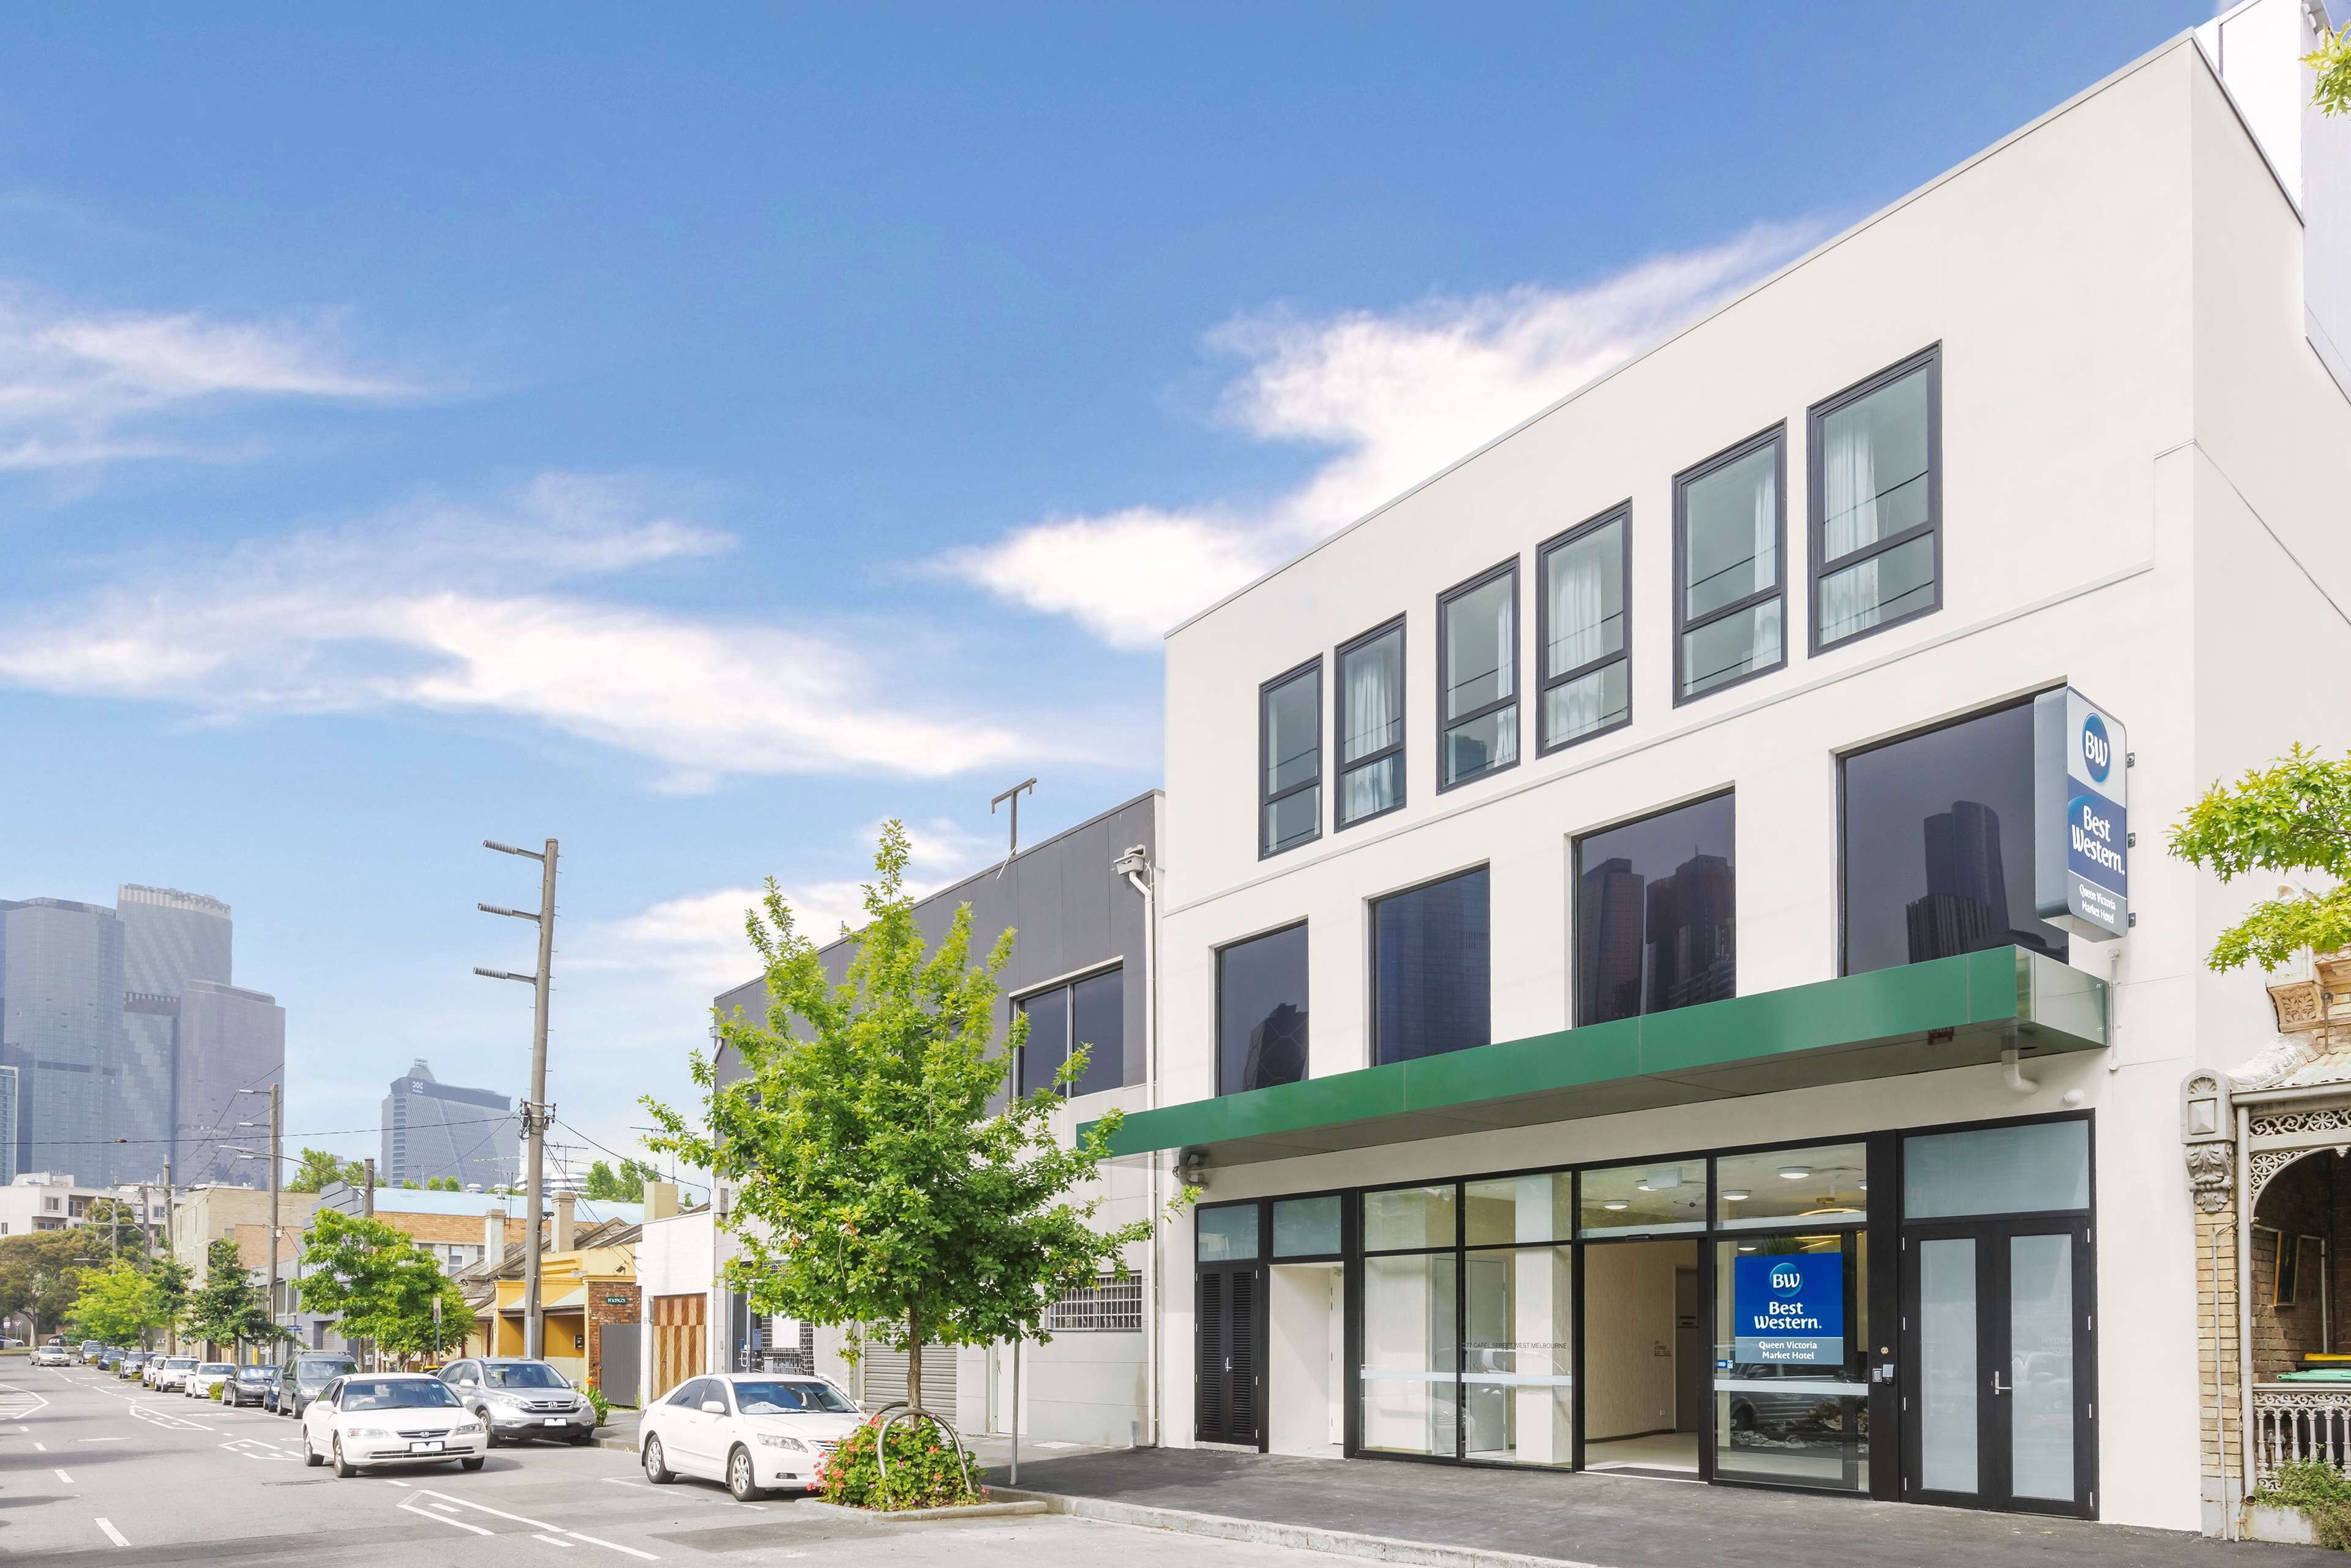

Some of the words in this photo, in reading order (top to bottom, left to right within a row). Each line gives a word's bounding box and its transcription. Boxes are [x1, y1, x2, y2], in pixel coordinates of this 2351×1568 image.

[2085, 730, 2108, 767] BW
[2083, 805, 2110, 842] Best
[2079, 883, 2096, 901] Queen
[2096, 892, 2116, 911] Victoria
[2082, 900, 2100, 918] Market
[2100, 909, 2114, 924] Hotel
[1772, 1273, 1800, 1288] BW
[1769, 1302, 1804, 1315] Best
[1758, 1341, 1785, 1350] Queen
[1786, 1340, 1818, 1349] Victoria
